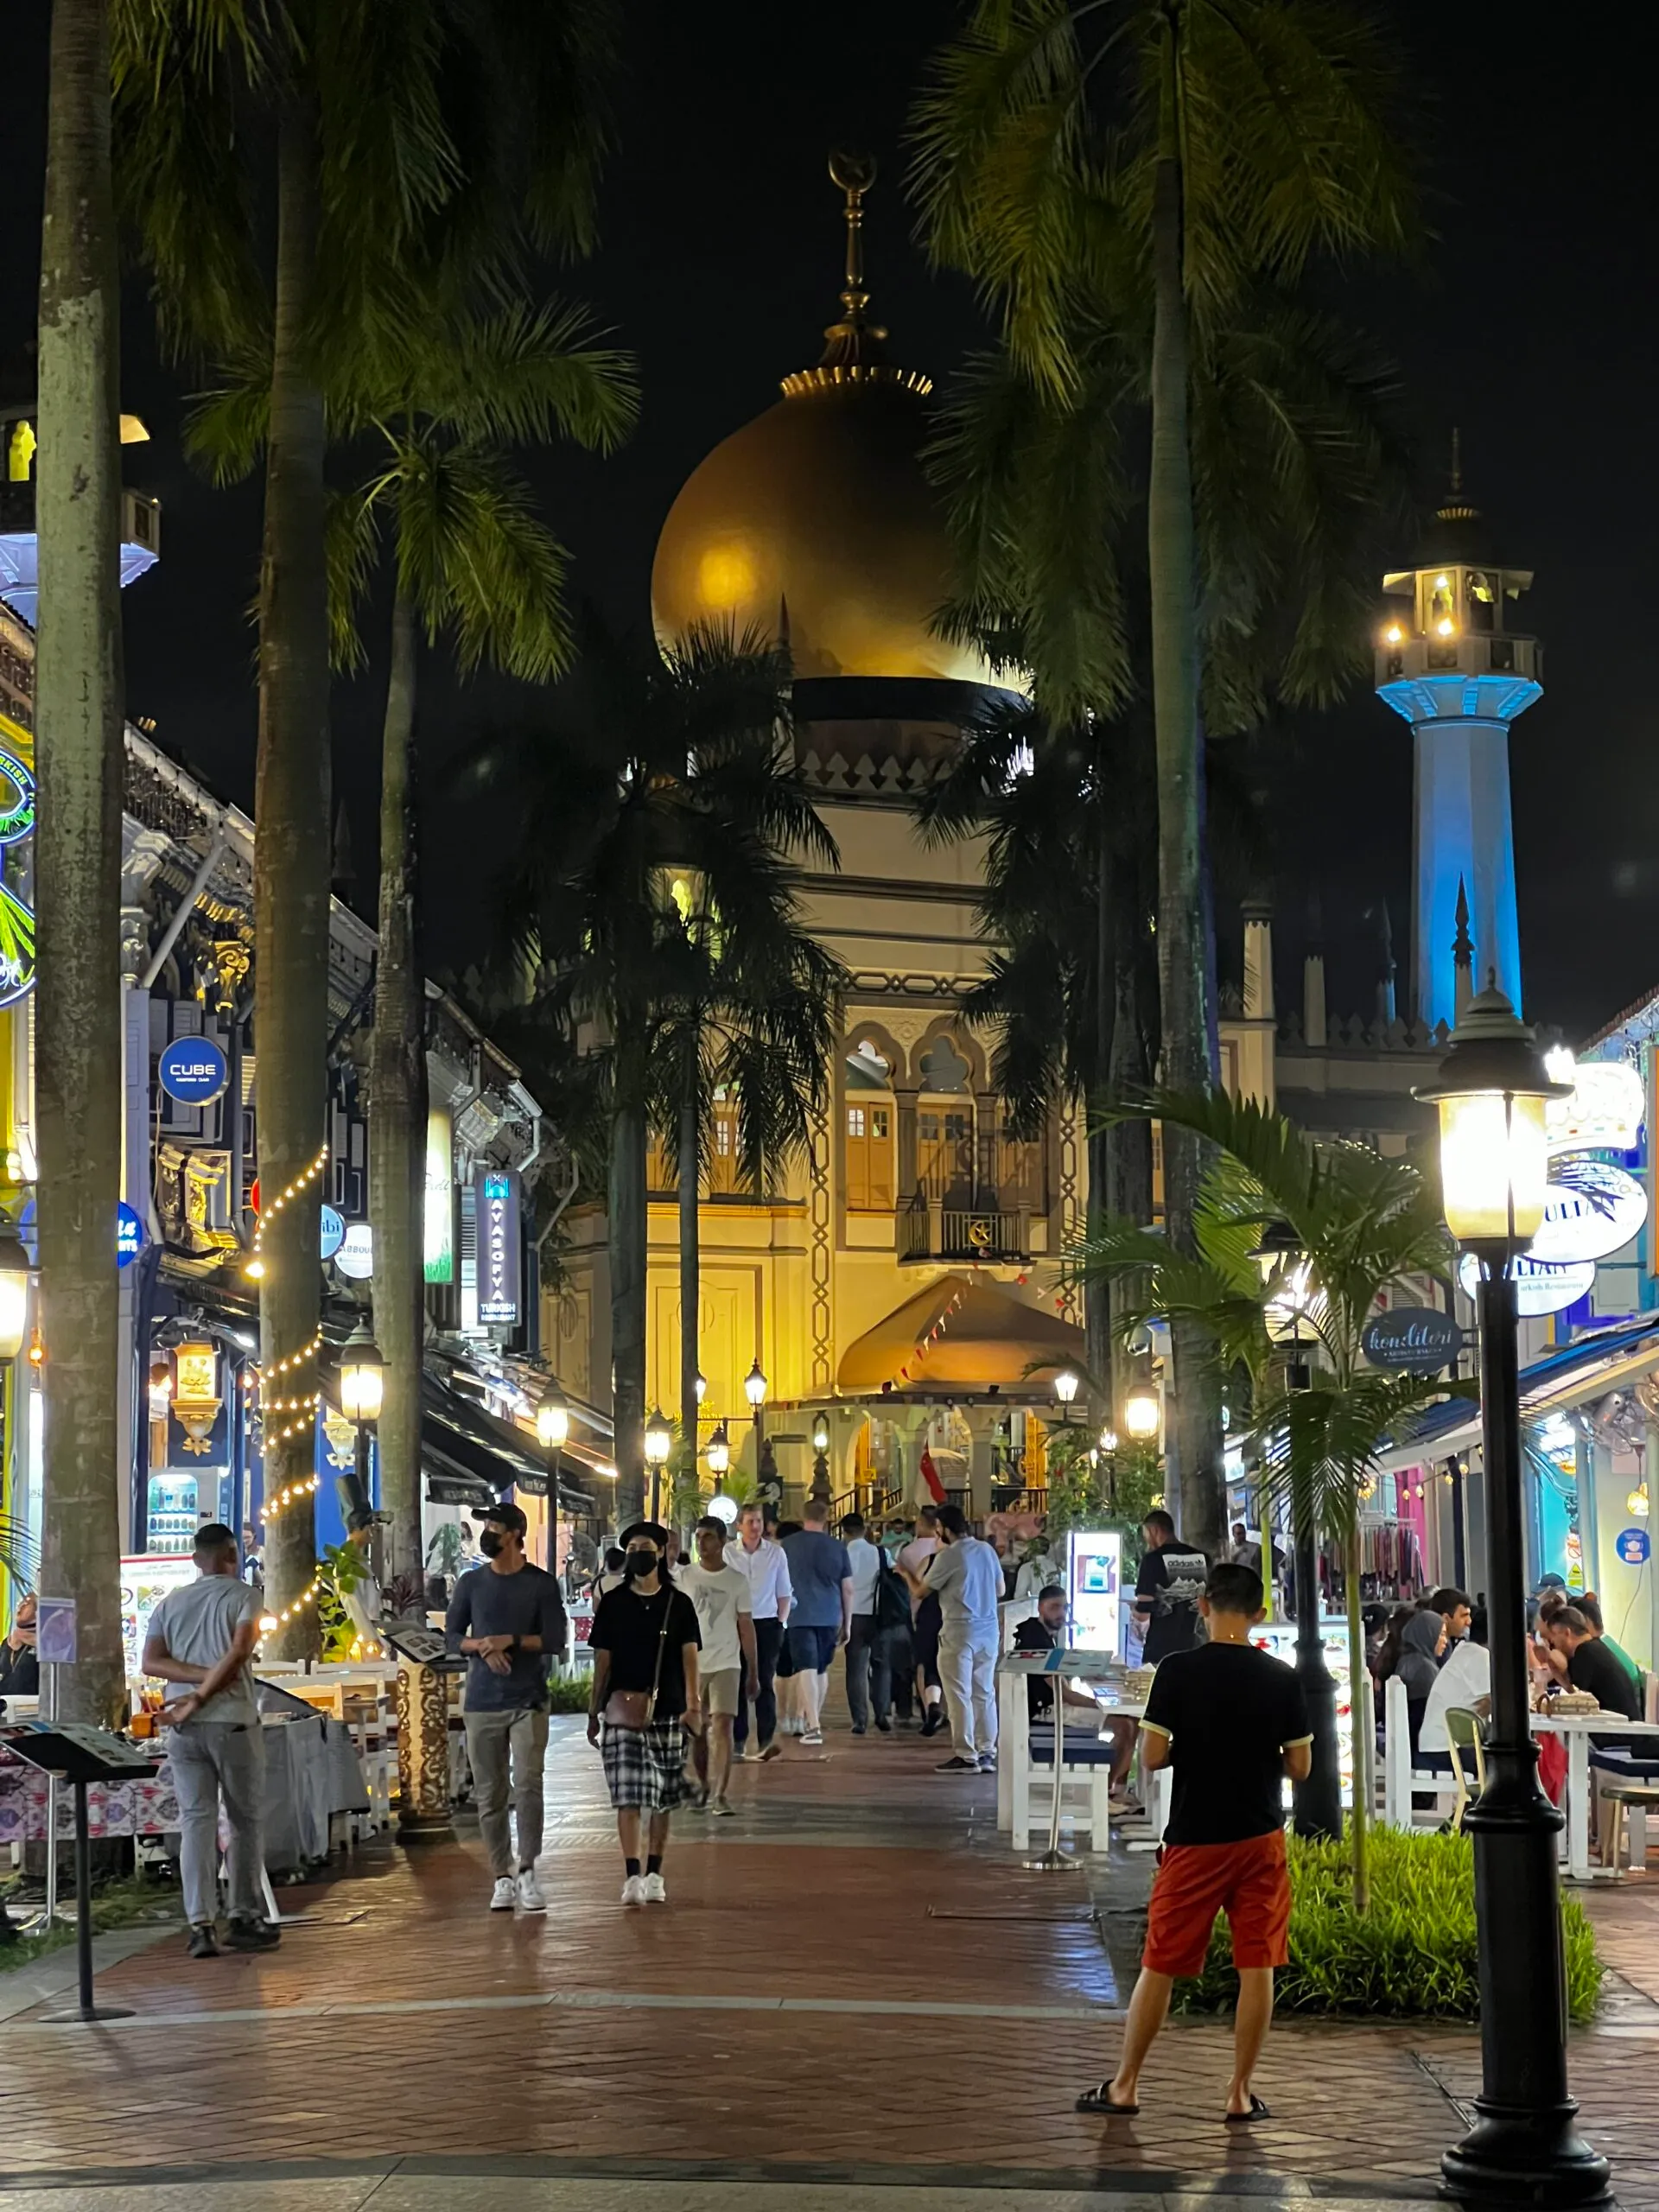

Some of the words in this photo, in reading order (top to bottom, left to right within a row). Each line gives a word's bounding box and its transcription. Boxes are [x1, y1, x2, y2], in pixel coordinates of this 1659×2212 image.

[169, 1064, 216, 1076] CUBE
[491, 1198, 505, 1301] AYASOFYA
[480, 1302, 517, 1313] TURKISH
